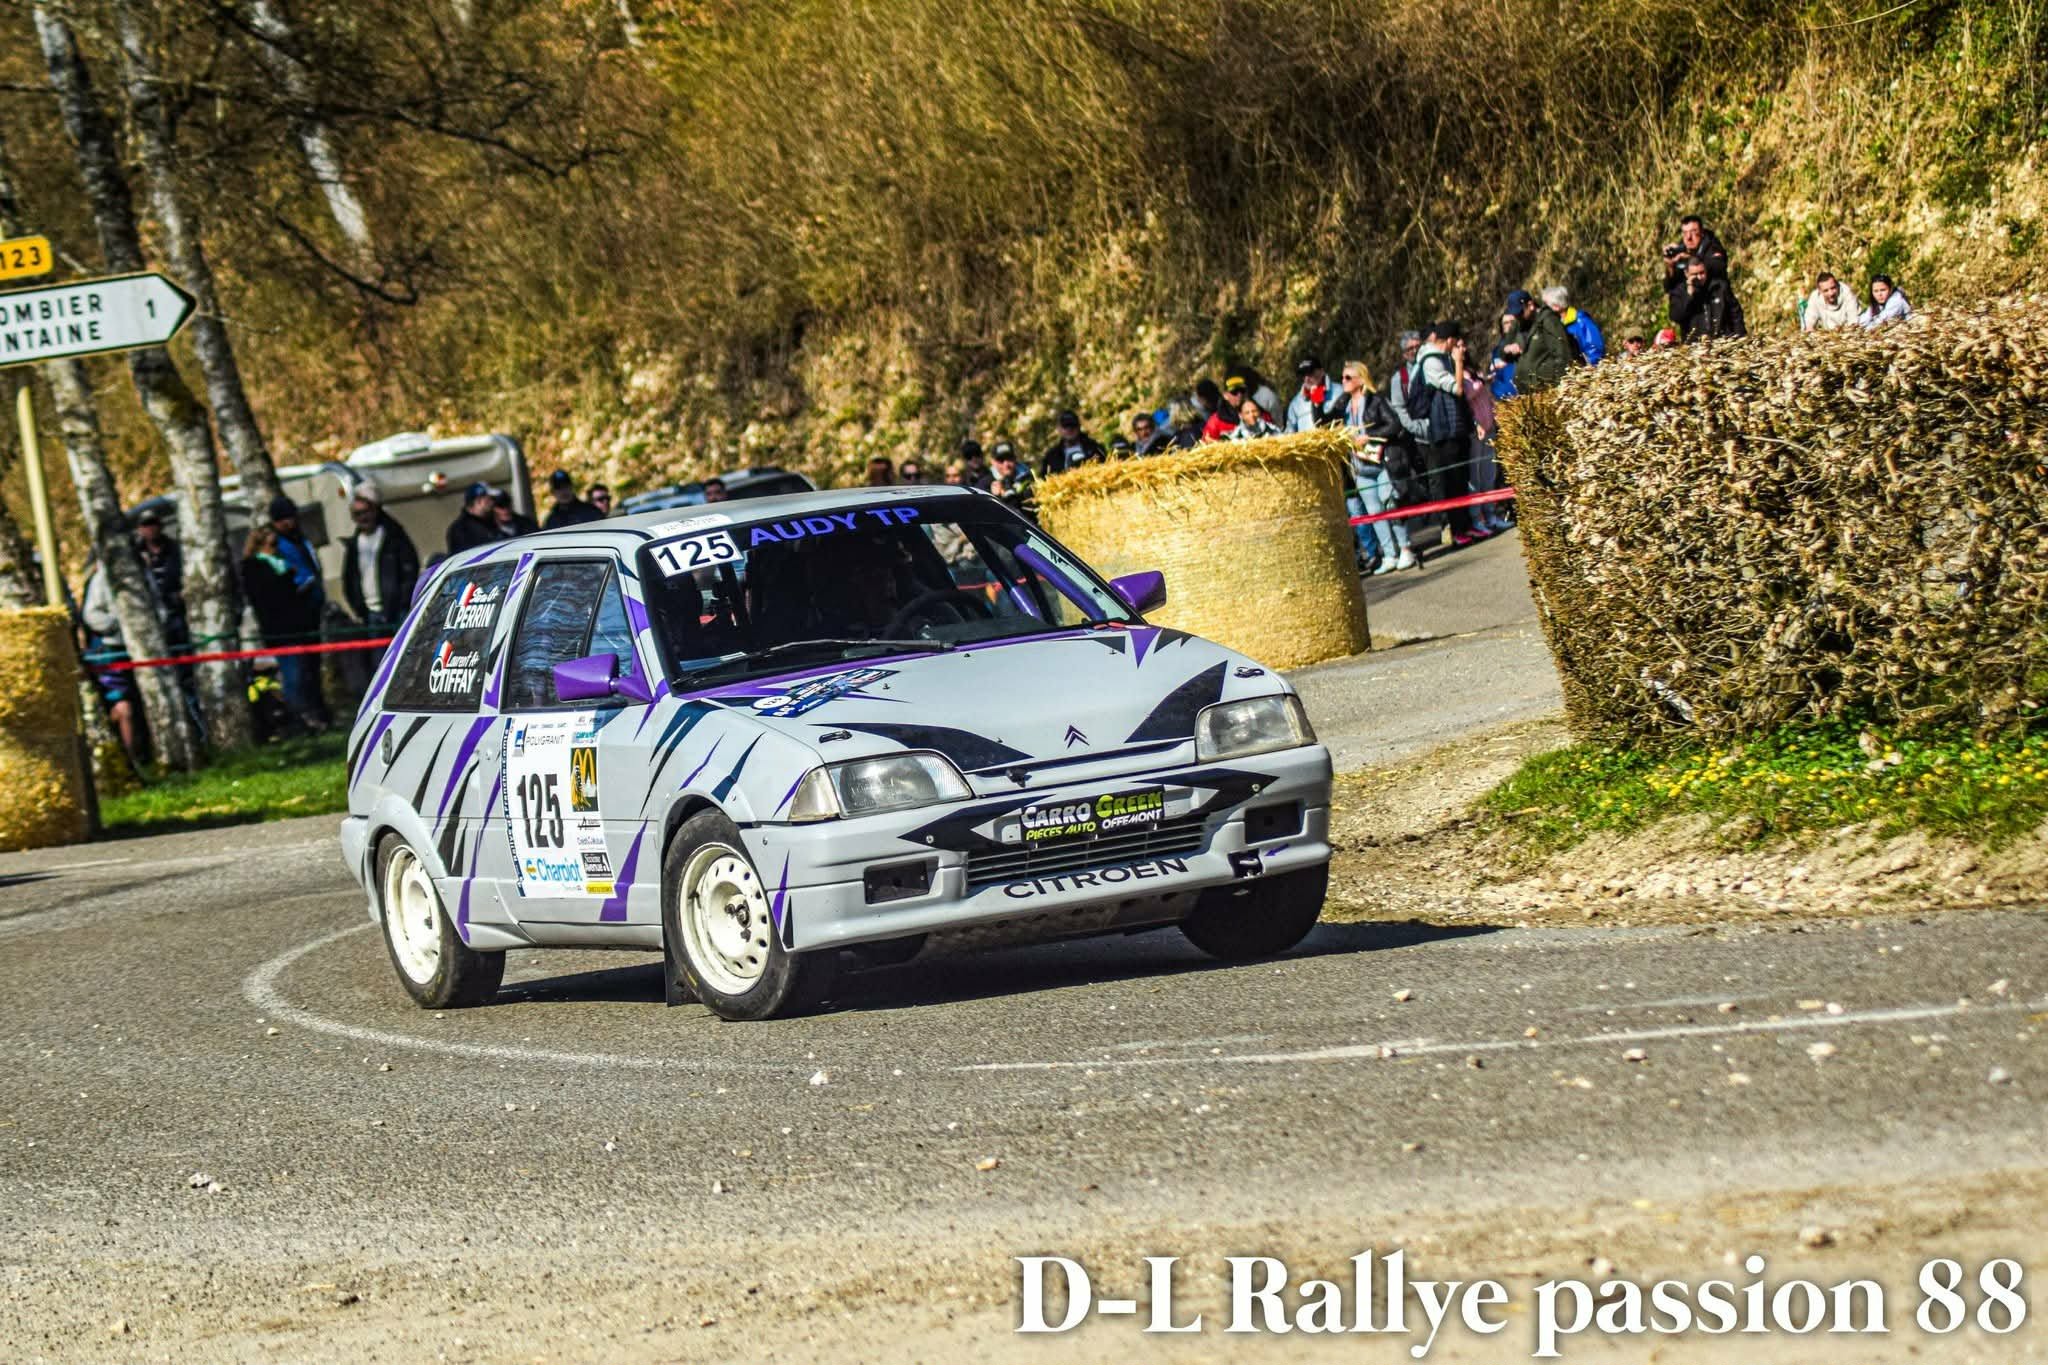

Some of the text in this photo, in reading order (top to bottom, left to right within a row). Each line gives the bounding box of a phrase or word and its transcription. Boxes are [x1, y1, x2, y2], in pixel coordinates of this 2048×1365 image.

[145, 298, 156, 319] 1
[751, 507, 920, 547] AUDY TP
[657, 534, 735, 571] 125
[454, 603, 496, 629] PERRIN
[438, 669, 477, 694] TIFFAY
[526, 734, 565, 746] POLYGRANIT
[517, 773, 564, 848] 125
[1023, 791, 1163, 828] CARRO GREEN
[1026, 809, 1162, 841] PIECES AUTO OFFEMONT
[537, 857, 583, 881] Charpiot
